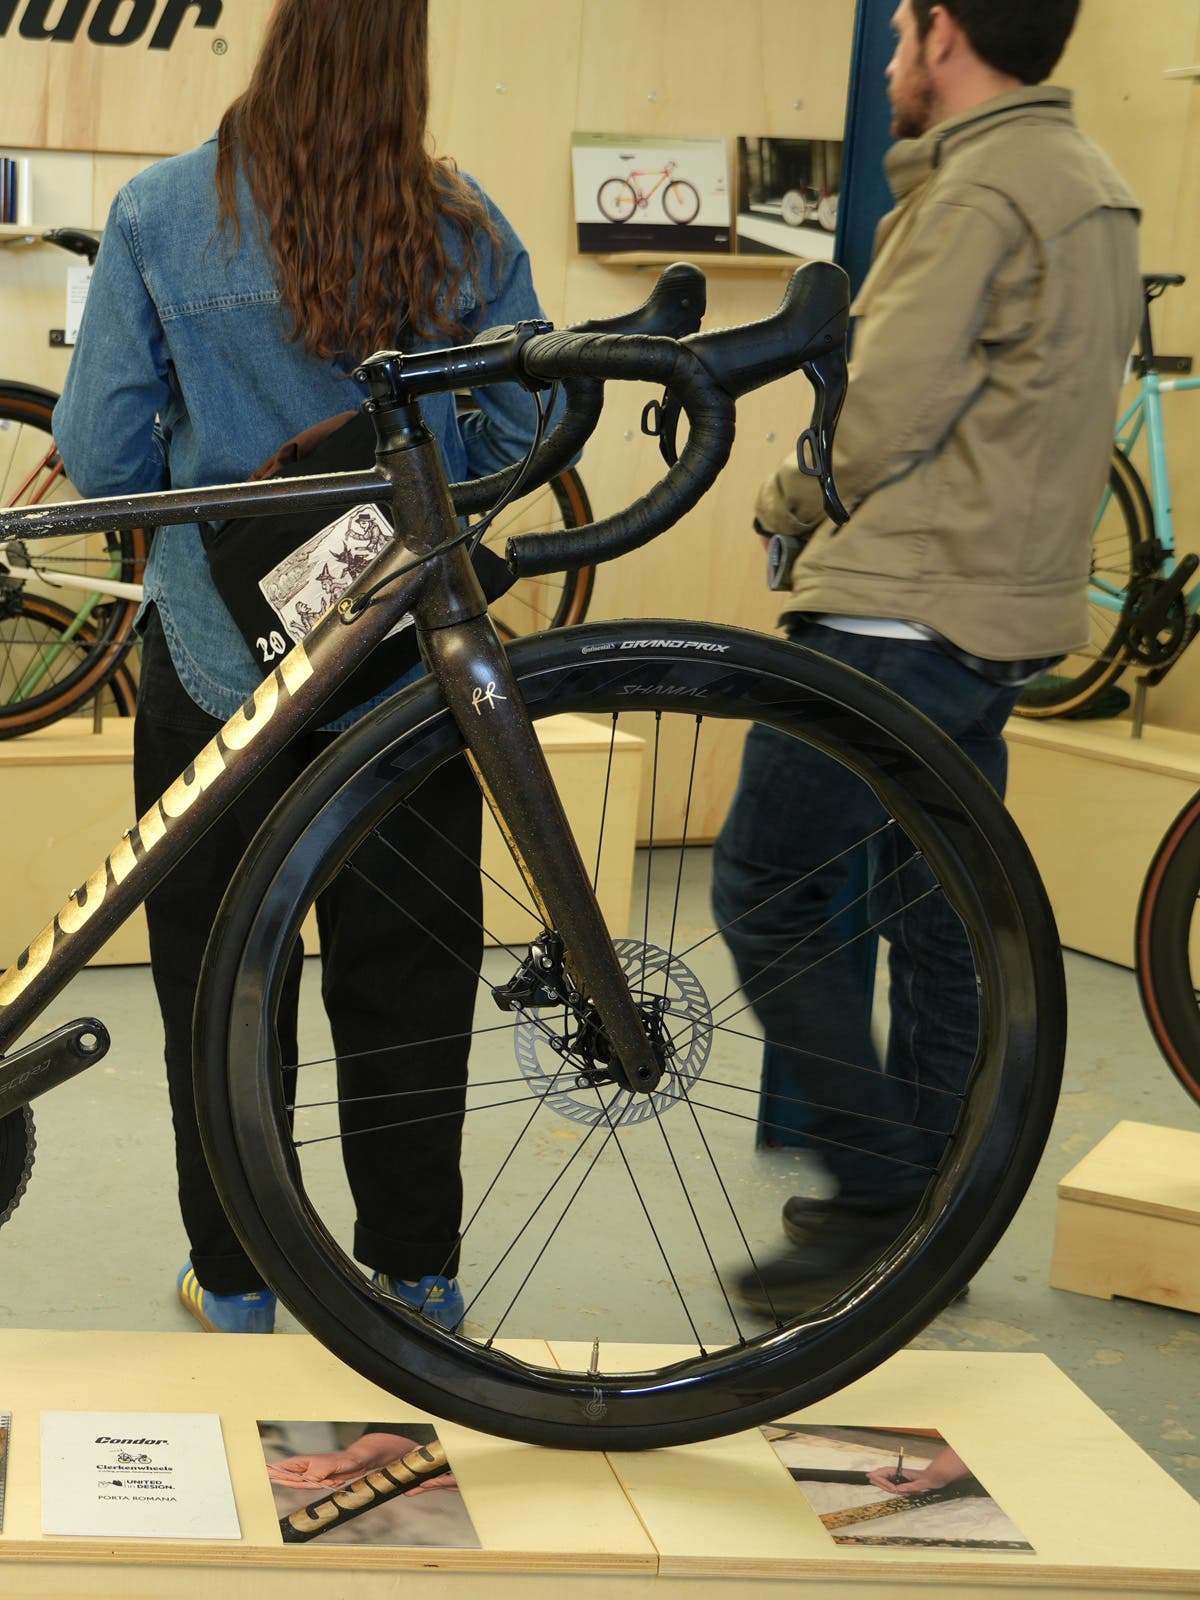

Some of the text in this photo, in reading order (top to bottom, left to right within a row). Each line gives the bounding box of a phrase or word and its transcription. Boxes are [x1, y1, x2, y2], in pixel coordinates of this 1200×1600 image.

[256, 630, 286, 662] 20
[620, 639, 682, 650] GRAND
[682, 640, 731, 653] PRIX
[615, 684, 709, 698] SHAMAL
[95, 1436, 167, 1445] Condor
